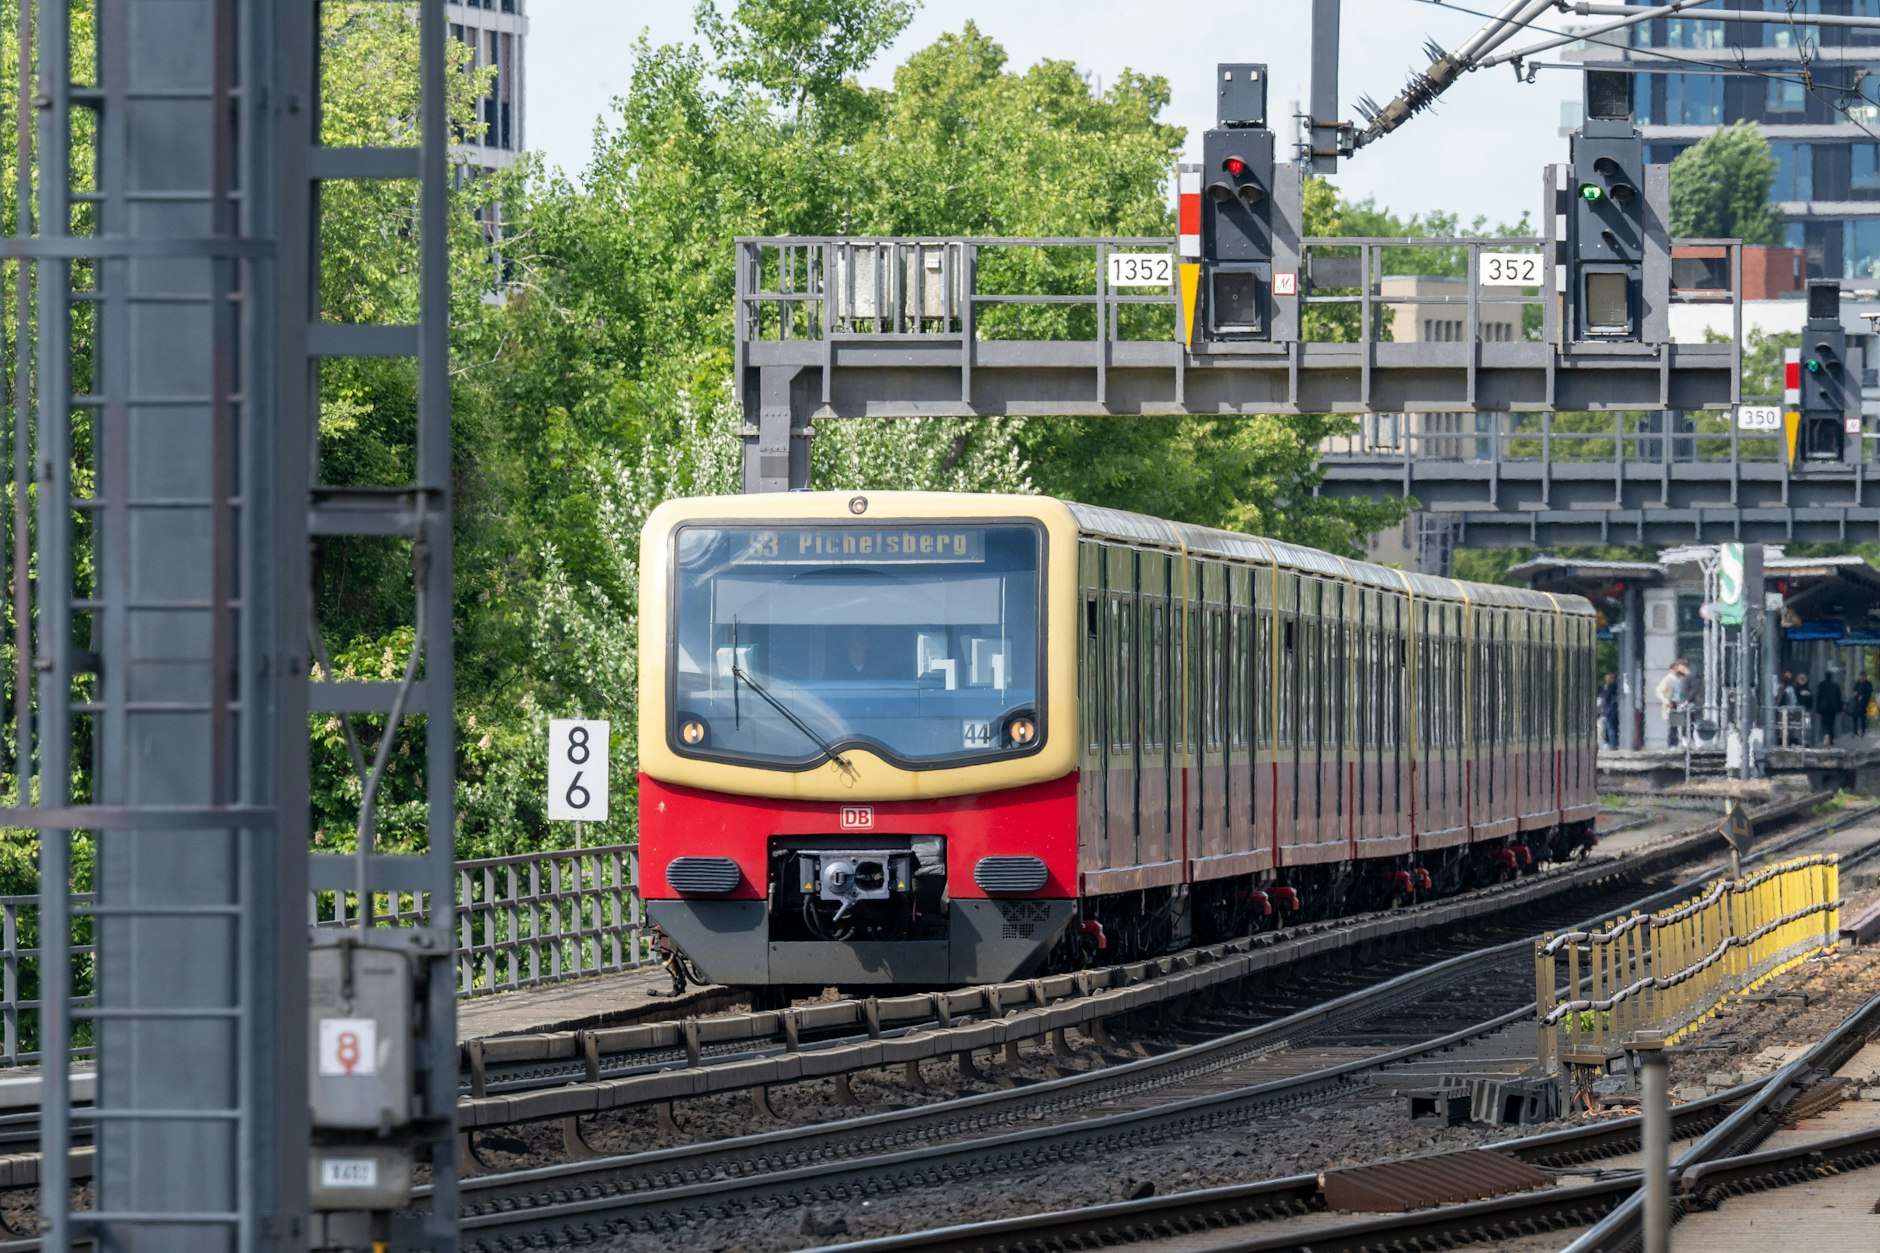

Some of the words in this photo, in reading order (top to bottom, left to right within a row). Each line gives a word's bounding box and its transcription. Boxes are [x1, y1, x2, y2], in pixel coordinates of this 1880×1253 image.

[1113, 259, 1169, 280] 1352
[1489, 259, 1535, 280] 352
[1744, 411, 1775, 425] 350
[800, 532, 966, 555] Pichelsberg
[964, 724, 989, 744] 44
[567, 726, 590, 765] 8
[565, 771, 590, 809] 6
[845, 810, 870, 825] DB
